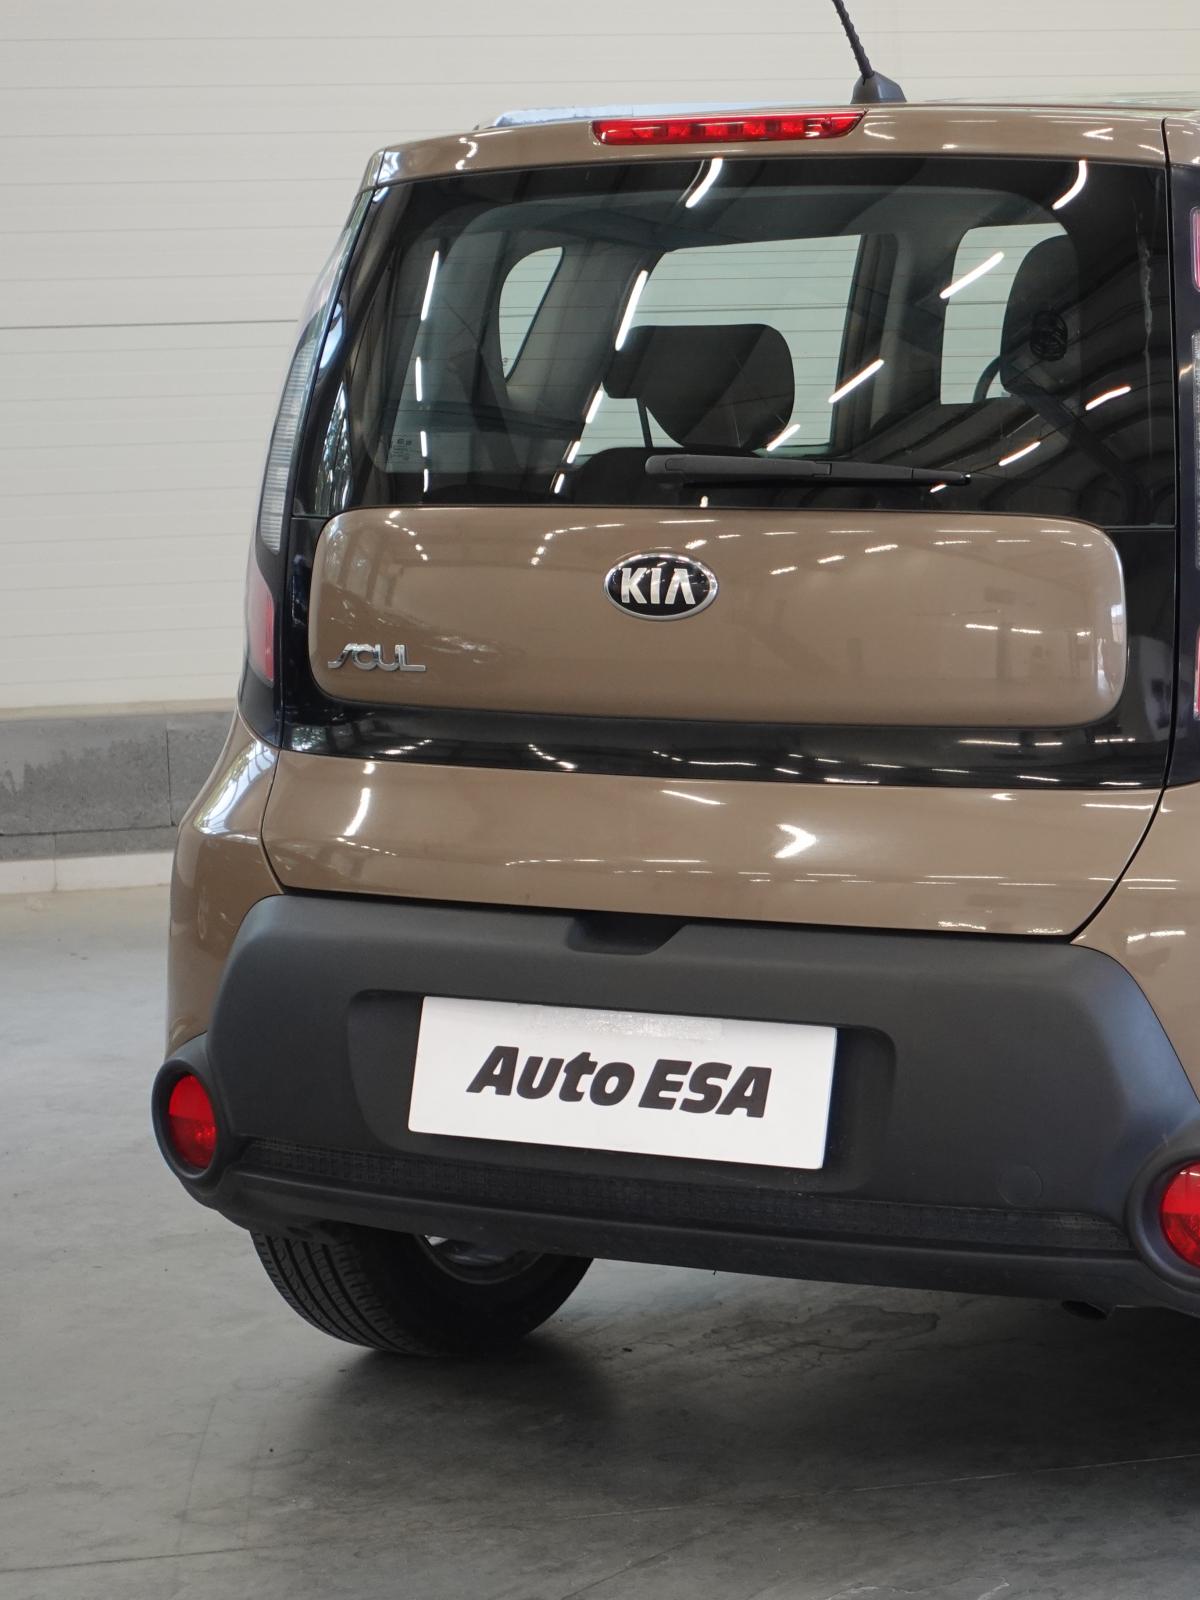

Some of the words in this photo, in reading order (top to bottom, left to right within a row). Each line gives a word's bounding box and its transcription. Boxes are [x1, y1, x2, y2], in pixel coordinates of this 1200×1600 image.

[620, 567, 696, 605] KIA
[327, 643, 426, 672] SOUL
[466, 1045, 635, 1107] Auto
[638, 1058, 772, 1119] ESA
